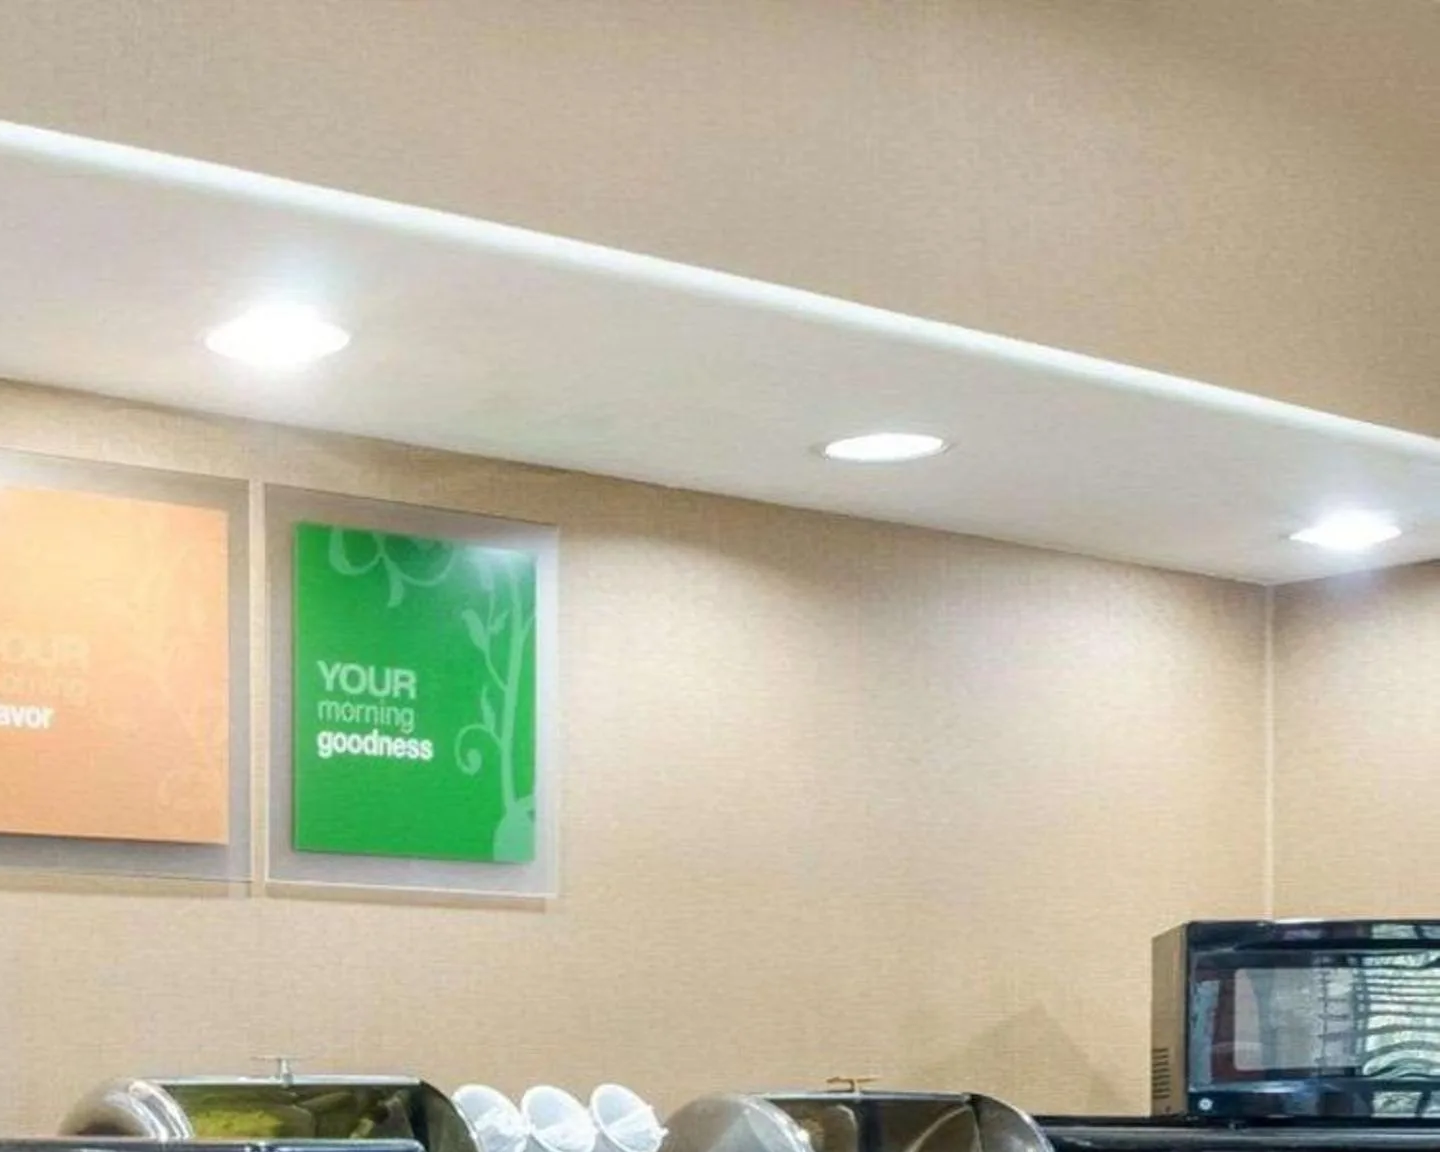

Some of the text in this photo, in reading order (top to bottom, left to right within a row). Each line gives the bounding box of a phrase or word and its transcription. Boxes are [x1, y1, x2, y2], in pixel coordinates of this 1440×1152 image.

[317, 660, 417, 699] YOUR
[318, 699, 415, 733] morning
[317, 729, 433, 761] goodness
